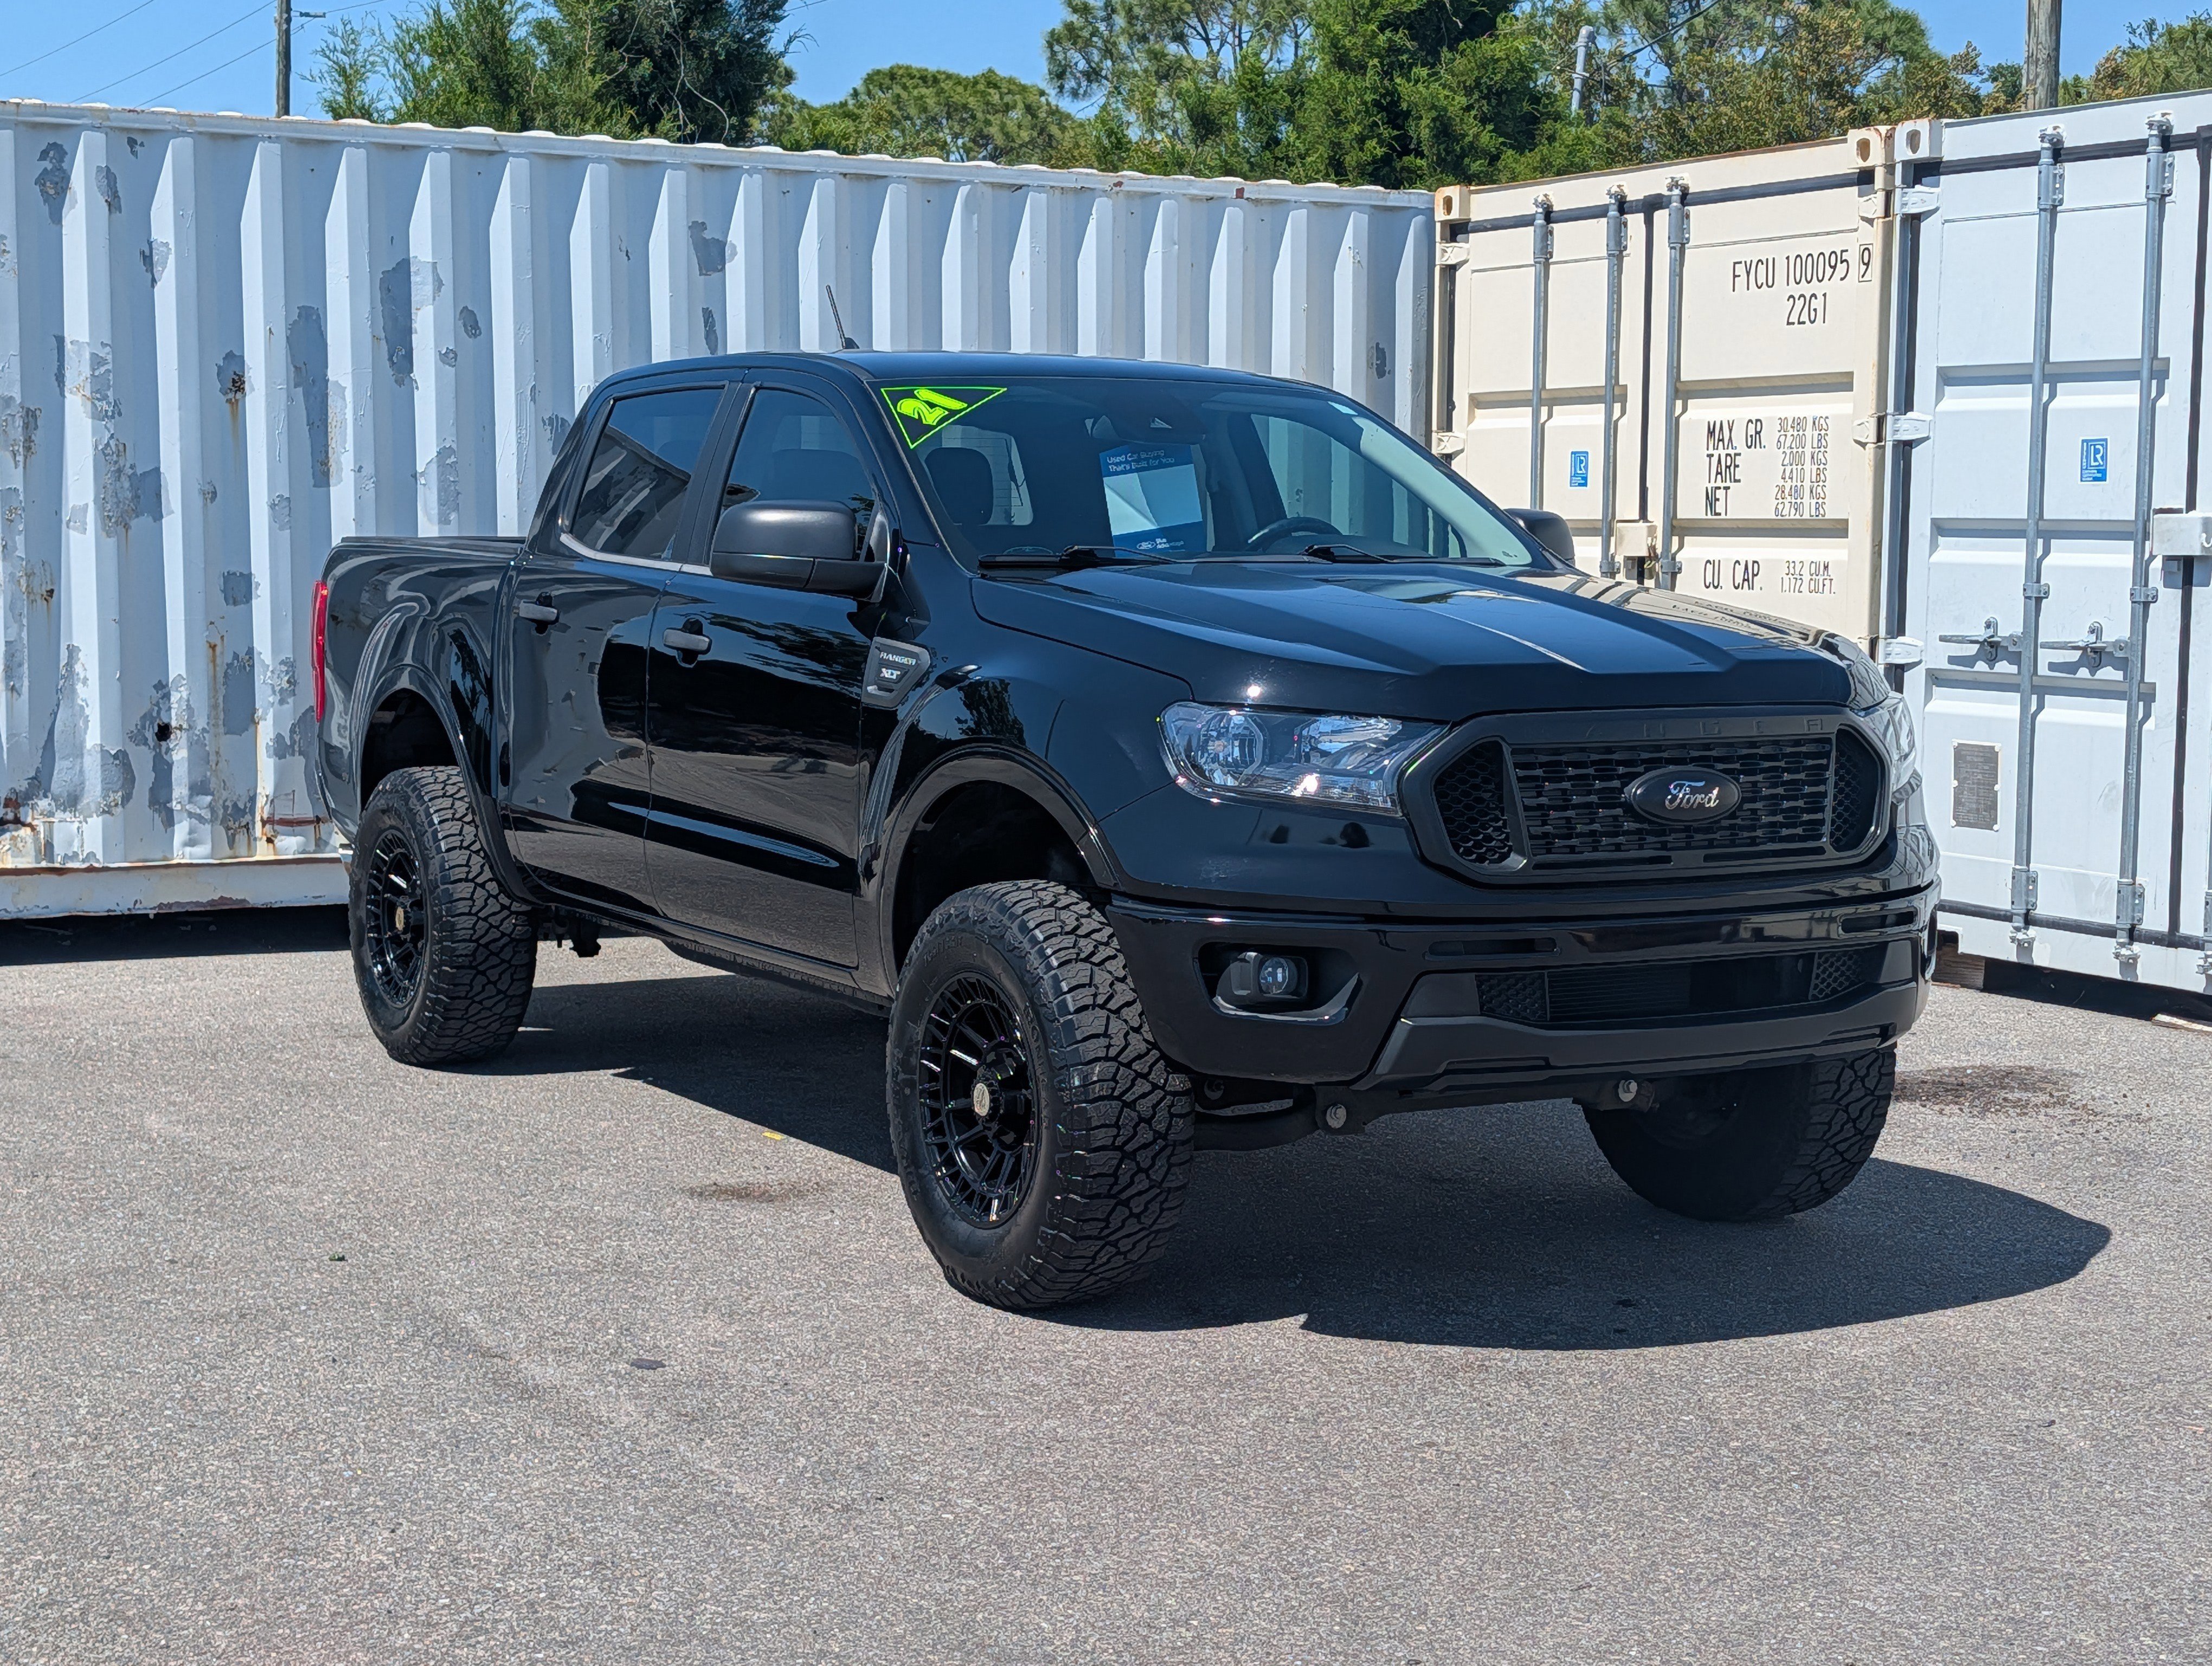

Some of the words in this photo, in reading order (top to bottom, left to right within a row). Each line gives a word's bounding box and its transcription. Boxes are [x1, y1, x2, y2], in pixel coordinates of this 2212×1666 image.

[1732, 257, 1776, 292] FYCU
[1785, 249, 1850, 286] 100095
[1861, 247, 1872, 279] 9
[1786, 292, 1828, 326] 22G1
[897, 388, 968, 425] 21
[1706, 419, 1737, 451] MAX.
[1745, 418, 1766, 449] GR.
[1811, 415, 1829, 432] KGS
[1811, 433, 1829, 449] LBS
[1706, 452, 1741, 483] TARE
[1810, 450, 1828, 466] KGS
[1810, 467, 1827, 483] LBS
[1705, 486, 1731, 516] NET
[1775, 484, 1804, 500] 28.480
[1809, 484, 1827, 500] KGS
[1809, 502, 1826, 517] LBS
[1703, 559, 1723, 589] CU.
[1732, 560, 1763, 591] CAP.
[1785, 560, 1804, 576] 33.2
[1780, 577, 1804, 593] 1.172
[879, 651, 917, 665] RANGER
[879, 668, 901, 680] XLT
[1664, 780, 1720, 810] Ford
